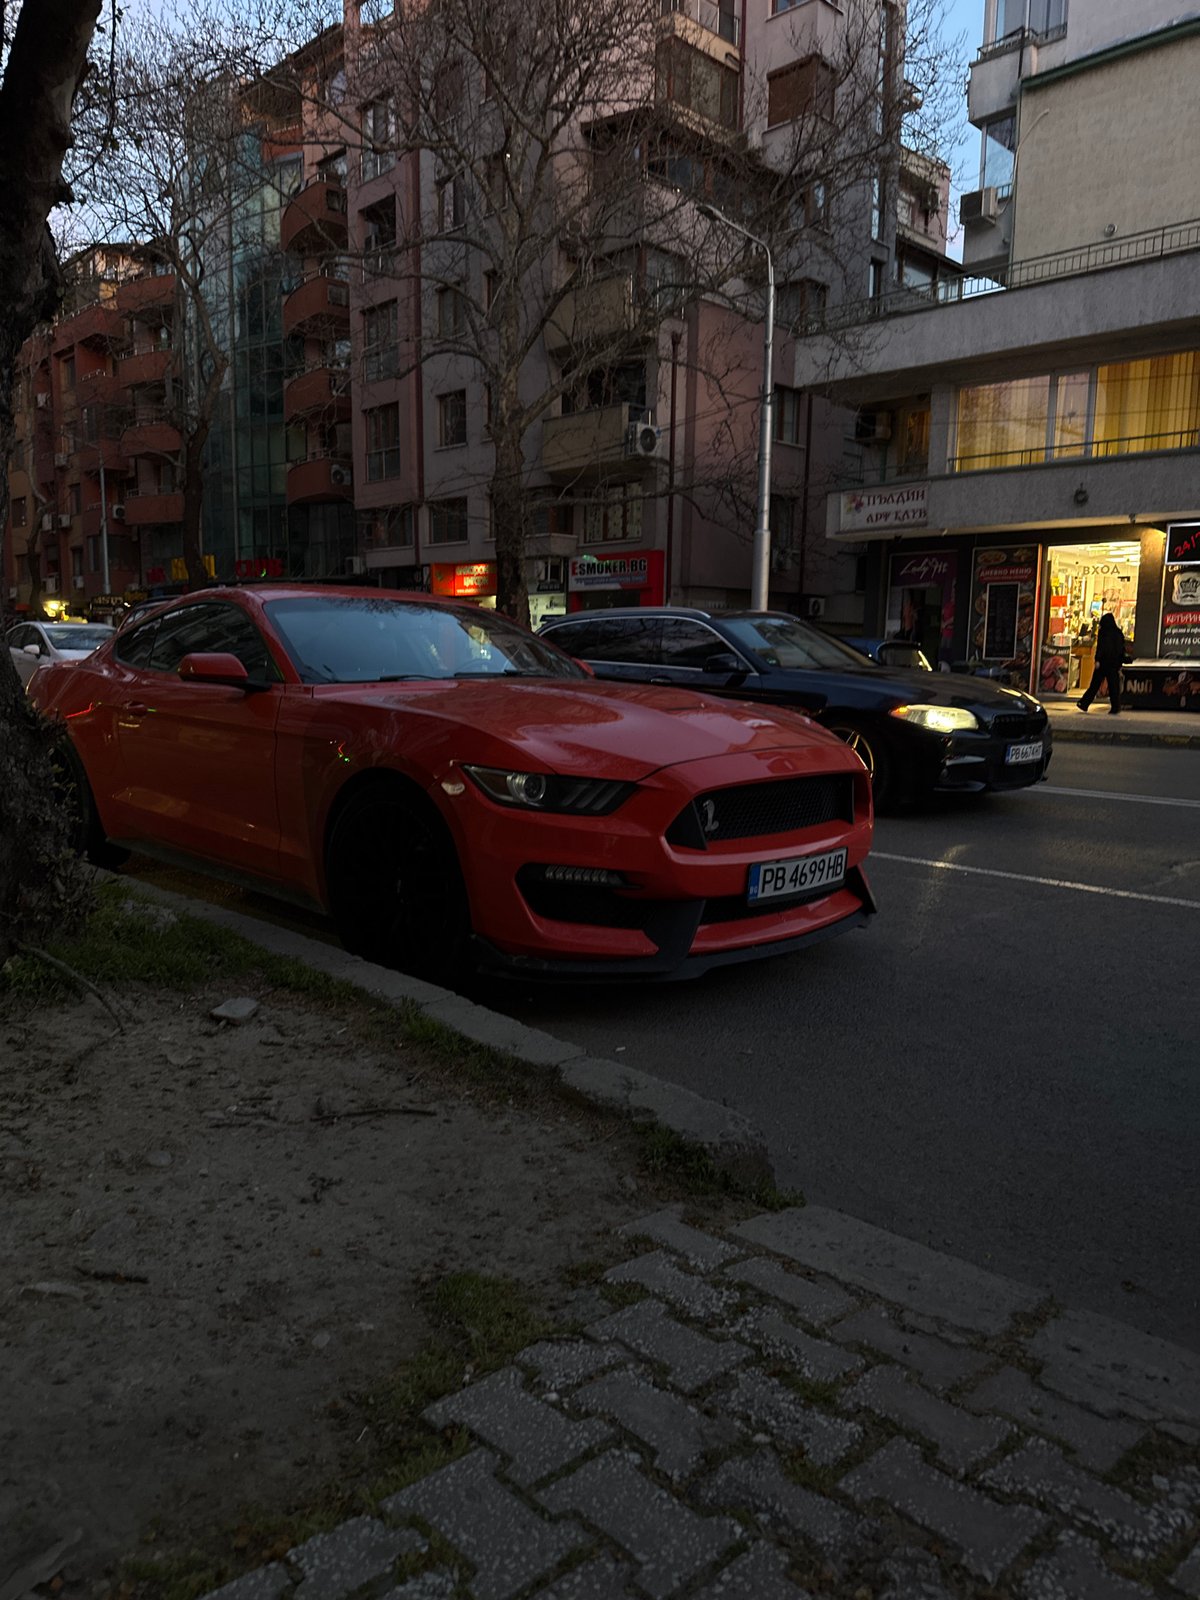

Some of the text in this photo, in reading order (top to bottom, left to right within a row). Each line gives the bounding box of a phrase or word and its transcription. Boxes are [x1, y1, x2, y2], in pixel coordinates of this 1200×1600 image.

[867, 490, 925, 506] ПЪЛДИН
[571, 560, 647, 576] ESMOKER.BG
[1083, 565, 1120, 575] ВХОД
[761, 854, 844, 893] PB 4699 HB
